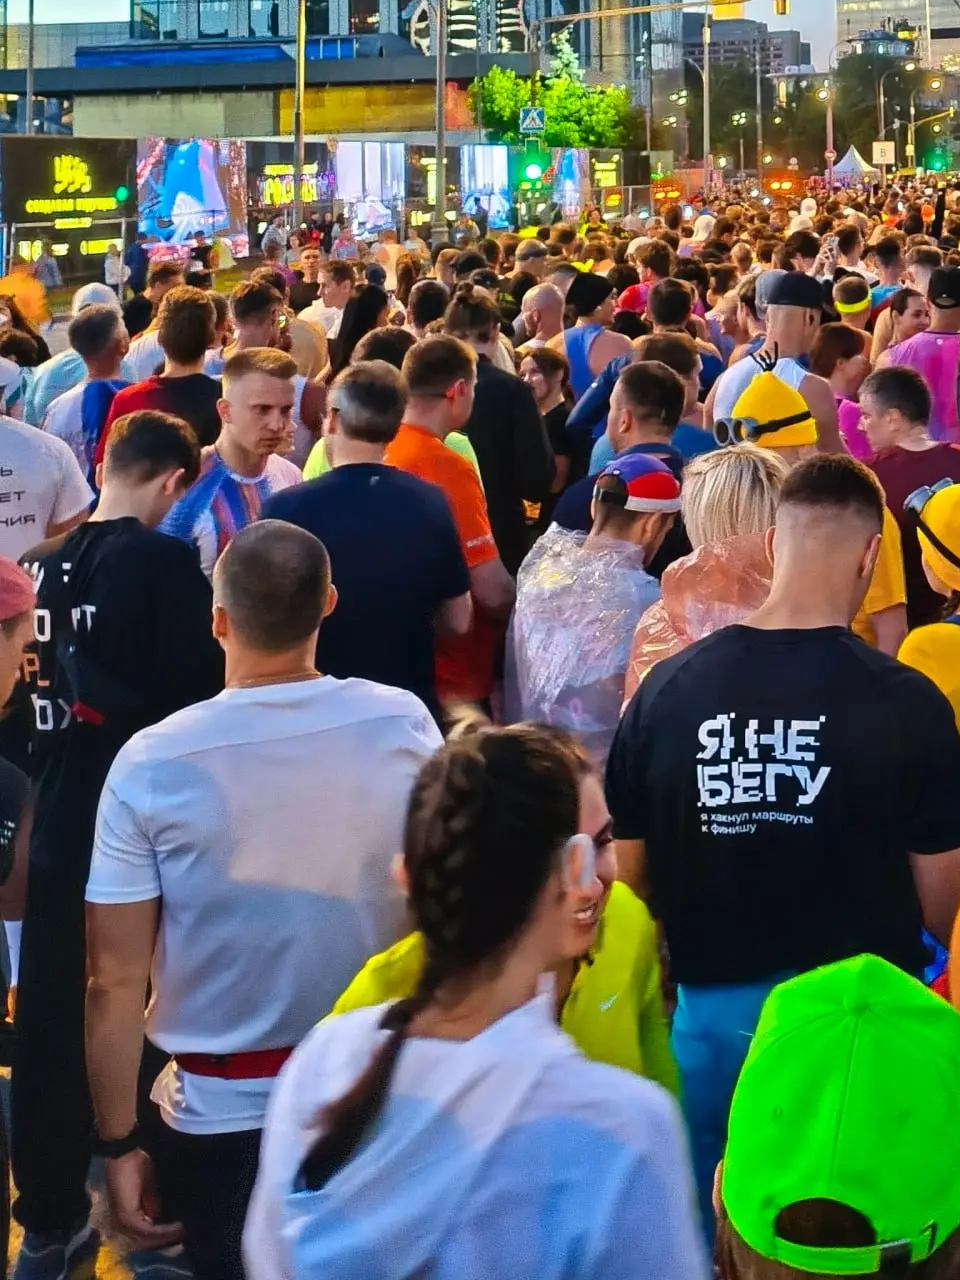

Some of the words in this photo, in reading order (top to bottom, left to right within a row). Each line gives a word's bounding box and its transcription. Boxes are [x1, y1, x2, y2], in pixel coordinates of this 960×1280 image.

[696, 713, 736, 760] Я
[745, 715, 826, 762] НЕ
[697, 757, 832, 807] БЕГУ
[701, 825, 709, 833] к
[710, 823, 757, 836] финишу
[710, 812, 749, 824] хакнул
[752, 810, 814, 825] маршруты
